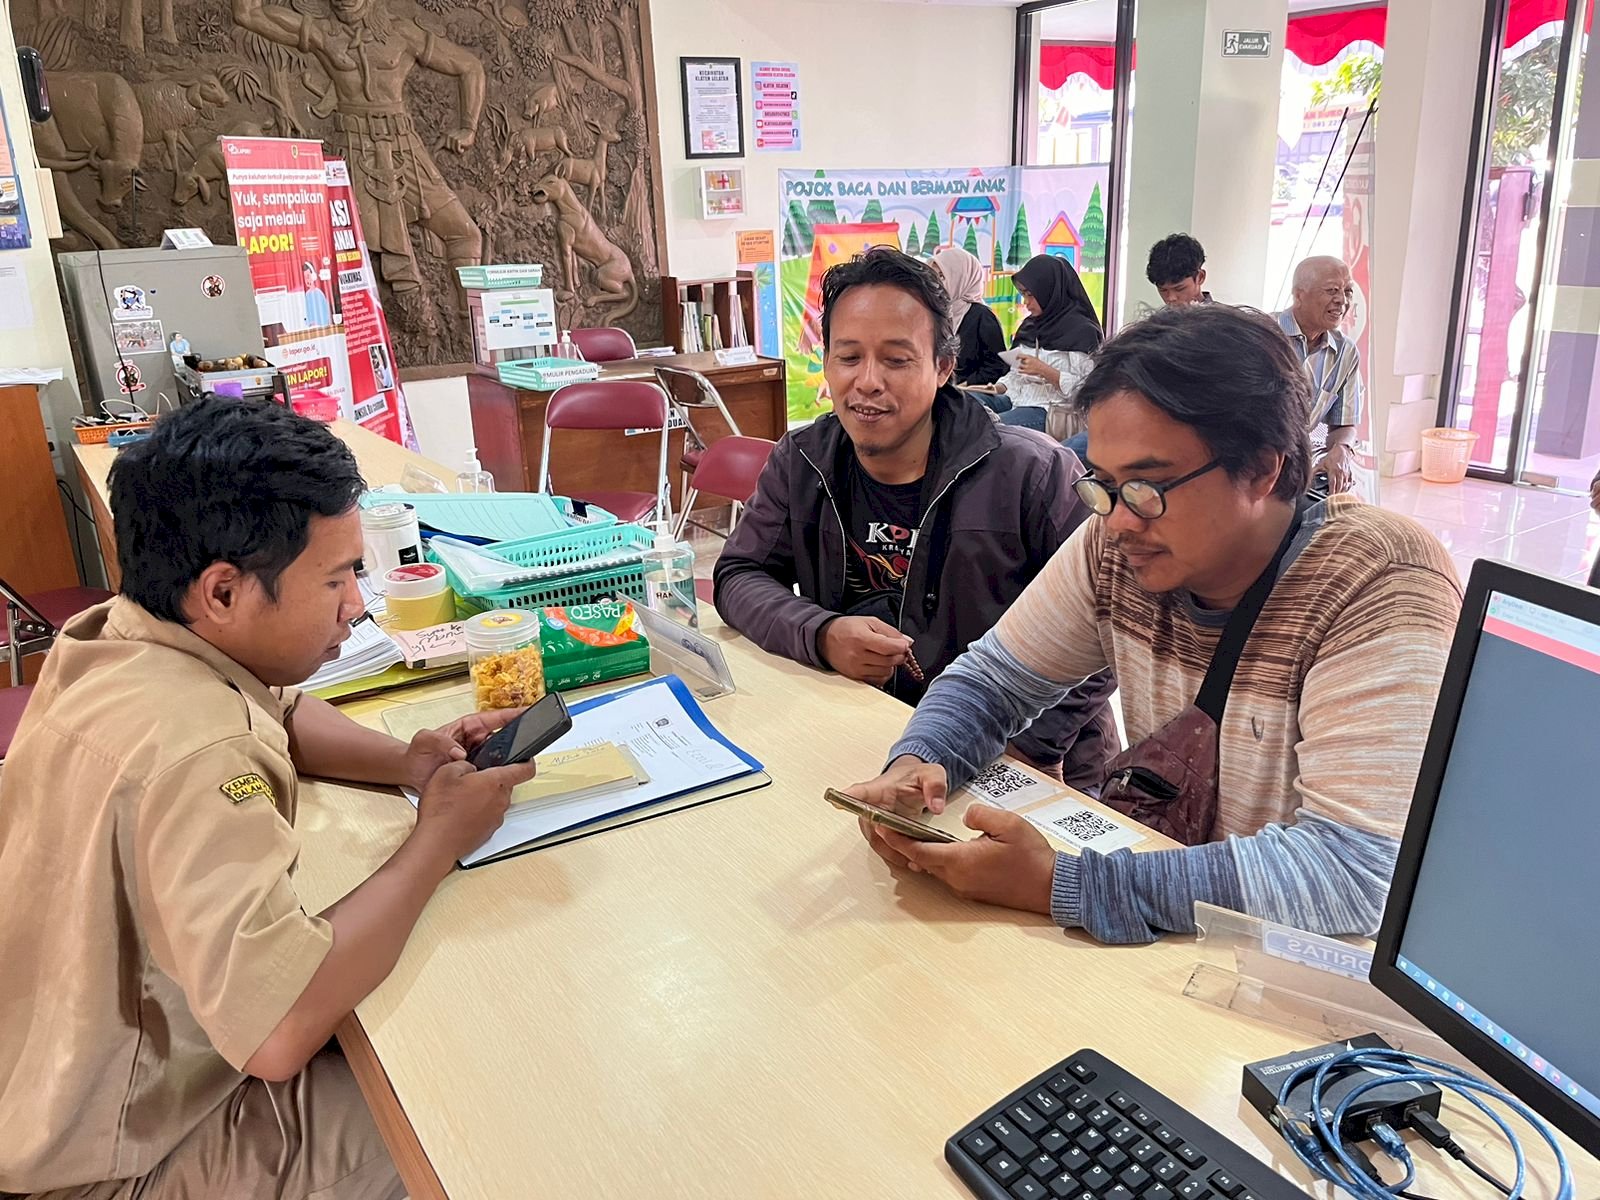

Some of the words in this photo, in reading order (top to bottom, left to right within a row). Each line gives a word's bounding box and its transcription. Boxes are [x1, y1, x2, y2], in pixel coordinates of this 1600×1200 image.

[785, 181, 833, 197] POJOK
[837, 181, 873, 196] BACA
[877, 181, 907, 196] DAN
[911, 179, 970, 195] BERMAIN
[973, 178, 1006, 193] ANAK
[234, 190, 261, 208] Yuk,
[262, 189, 324, 209] sampaikan
[237, 211, 263, 232] saja
[265, 209, 307, 225] melalui
[298, 366, 328, 383] LAPOR!
[564, 367, 597, 377] PENGADUAN
[571, 603, 621, 620] PASEO
